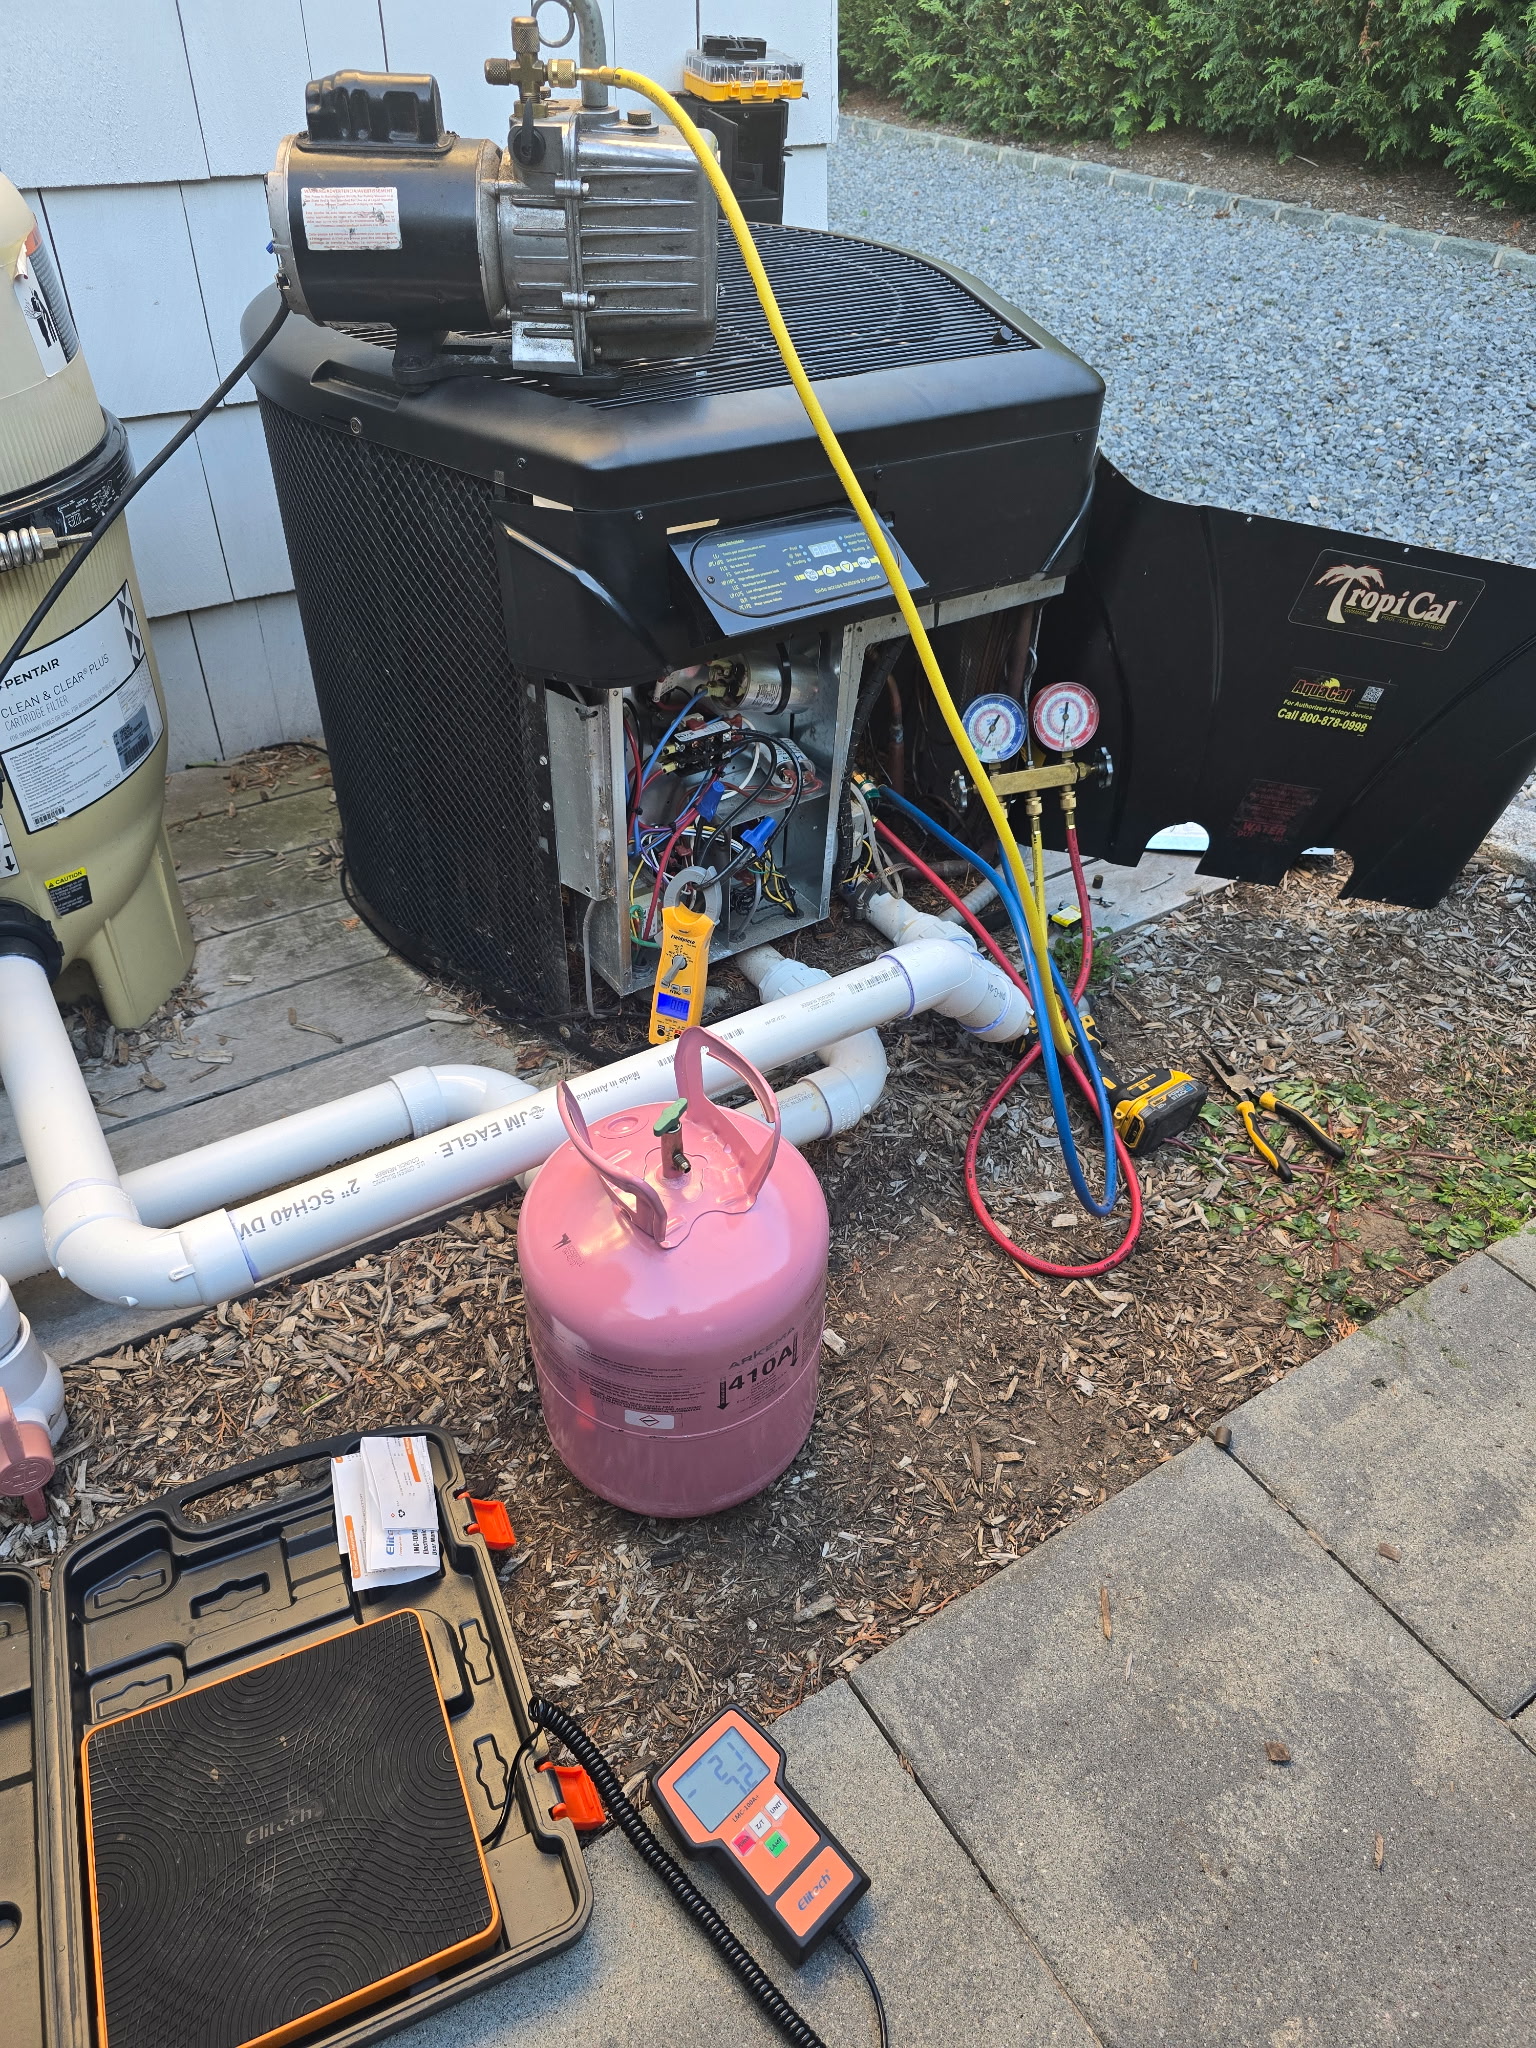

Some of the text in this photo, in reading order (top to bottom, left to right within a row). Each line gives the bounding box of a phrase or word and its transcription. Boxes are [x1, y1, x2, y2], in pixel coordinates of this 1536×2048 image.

[1344, 607, 1370, 618] SWIMMING
[1381, 615, 1396, 623] POOL
[1410, 620, 1424, 628] HEAT
[1423, 623, 1444, 632] PUMPS
[0, 694, 40, 719] CLEAN
[43, 690, 52, 701] &
[89, 653, 110, 675] PLUS
[4, 658, 60, 690] PENTAIR
[1291, 679, 1353, 703] AquaCal
[4, 694, 69, 732] CARTRIDGE FILTER
[1277, 708, 1368, 733] Call 800-878-0998
[1294, 701, 1328, 712] Authorized
[1327, 707, 1351, 717] Factory
[1350, 711, 1373, 720] Service
[9, 735, 19, 743] FOR
[55, 870, 83, 885] CAUTION
[619, 1071, 641, 1084] Made
[576, 1084, 609, 1101] America
[440, 1109, 529, 1158] JM EAGLE
[374, 1157, 420, 1179] COUNCIL MEMBER
[341, 1177, 361, 1199] 2"
[270, 1188, 335, 1226] SCH40
[728, 1327, 795, 1370] ARKEMA
[728, 1345, 793, 1391] 410A
[731, 1793, 760, 1824] LMC-100A+
[769, 1800, 783, 1814] UNIT
[246, 1808, 312, 1845] Elitech
[755, 1819, 765, 1830] Z/T
[768, 1836, 783, 1852] LAMP
[797, 1872, 831, 1911] Elitech
